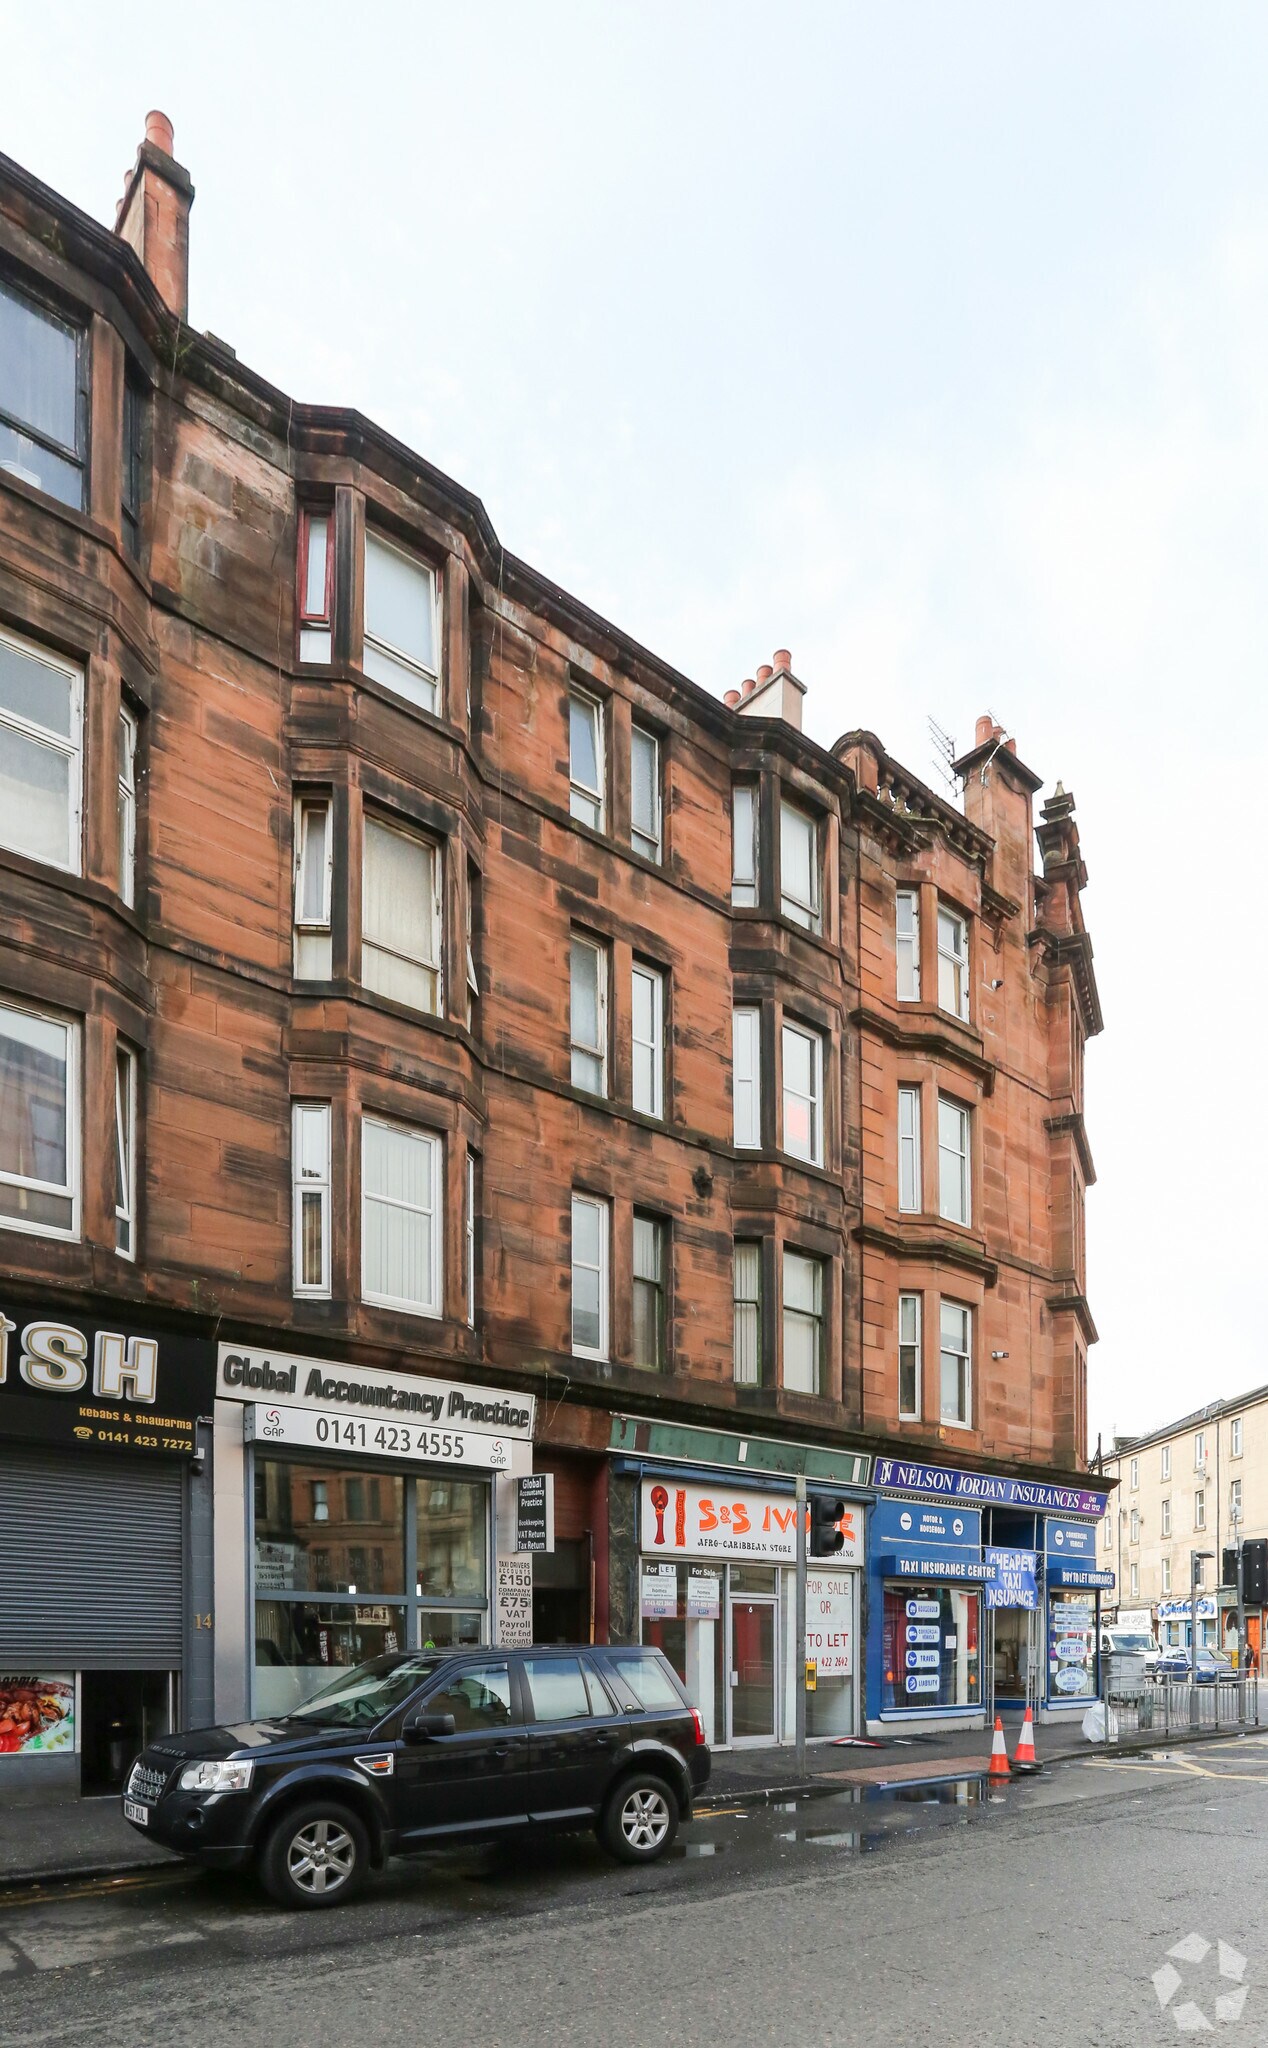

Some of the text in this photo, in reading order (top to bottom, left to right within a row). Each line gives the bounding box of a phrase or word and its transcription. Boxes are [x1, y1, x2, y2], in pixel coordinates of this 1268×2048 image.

[223, 1355, 529, 1428] Global Accountancy Practice
[123, 1413, 132, 1422] &
[262, 1426, 285, 1437] GAP
[98, 1430, 192, 1450] 0141 423 7272
[315, 1417, 464, 1459] 0141 423 4555
[489, 1455, 506, 1465] GAP
[522, 1478, 542, 1489] Global
[896, 1466, 954, 1491] NELSON
[956, 1476, 1006, 1499] JORDAN
[1009, 1484, 1081, 1509] INSURANCES
[519, 1489, 544, 1497] Accountancy
[521, 1498, 543, 1507] Practice
[699, 1499, 751, 1534] S&S
[922, 1514, 939, 1524] MOTOR
[518, 1530, 545, 1538] VAT Return
[919, 1524, 946, 1535] HOUSEHOLD
[1065, 1531, 1088, 1540] COMMERCIAL
[518, 1541, 545, 1550] Tax Return
[698, 1538, 767, 1551] AFRO-CARIBBEAN
[769, 1544, 792, 1553] STORE
[1069, 1540, 1084, 1548] VEHICLE
[498, 1560, 530, 1569] TAXI DRIVERS
[990, 1552, 1035, 1572] CHEAPER
[646, 1565, 657, 1573] For
[703, 1569, 716, 1577] Sale
[900, 1560, 996, 1578] TAXI INSURANCE CENTRE
[499, 1573, 531, 1586] £150
[1003, 1572, 1021, 1589] TAXI
[1062, 1571, 1113, 1586] BUY TO LET INSURANCE
[806, 1581, 849, 1595] FOR SALE
[500, 1597, 528, 1608] £75
[988, 1589, 1034, 1607] INSURANCE
[820, 1601, 832, 1614] OR
[506, 1610, 526, 1618] VAT
[195, 1613, 212, 1631] 14
[500, 1620, 530, 1630] Payroll
[500, 1637, 532, 1645] Accounts
[807, 1634, 849, 1647] TO LET
[821, 1657, 832, 1667] 422
[835, 1657, 848, 1667] 2642
